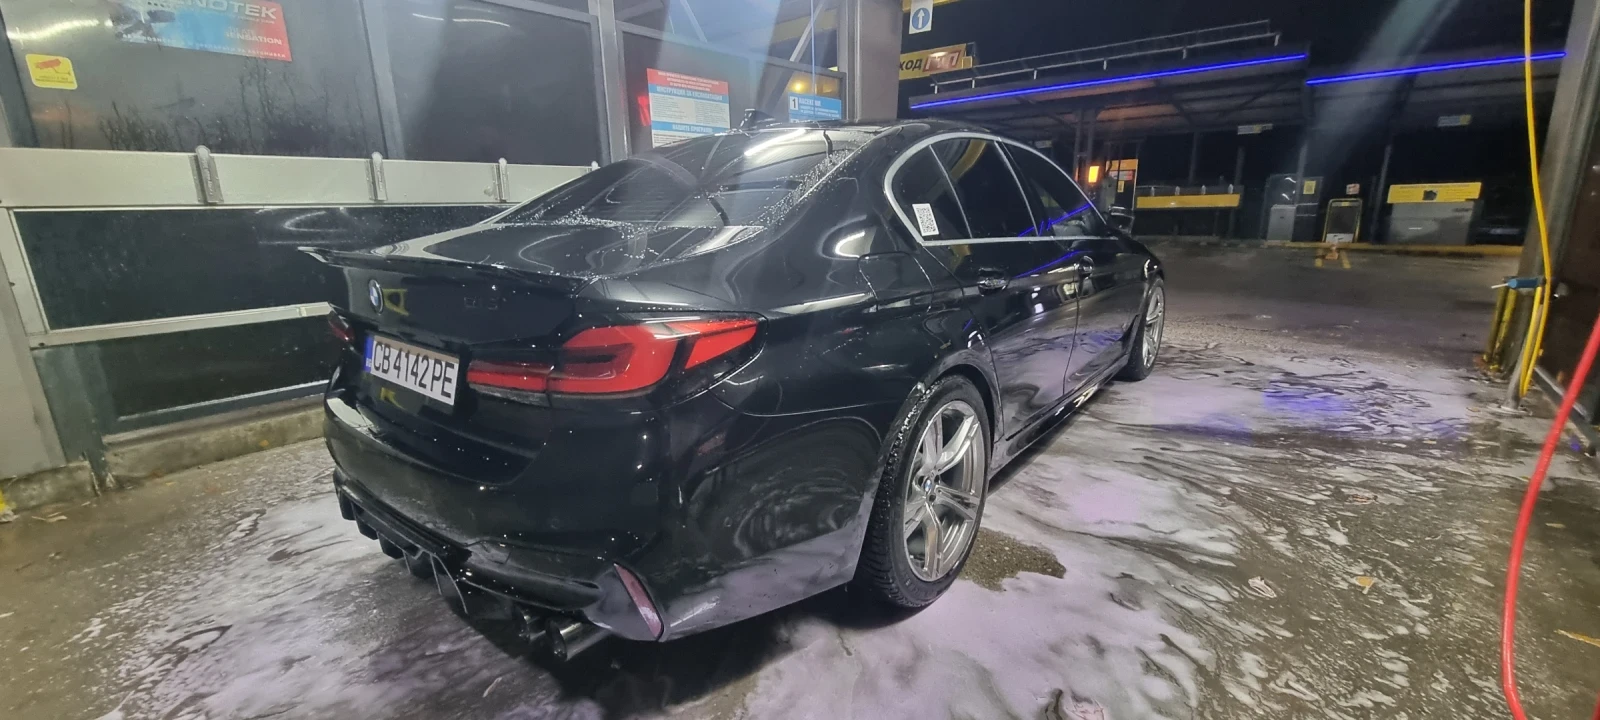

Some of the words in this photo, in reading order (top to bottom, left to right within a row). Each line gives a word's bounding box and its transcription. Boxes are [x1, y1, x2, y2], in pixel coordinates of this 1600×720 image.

[792, 97, 797, 109] 1
[373, 341, 391, 374] CB
[393, 347, 430, 390] 4142
[430, 357, 455, 399] PE
